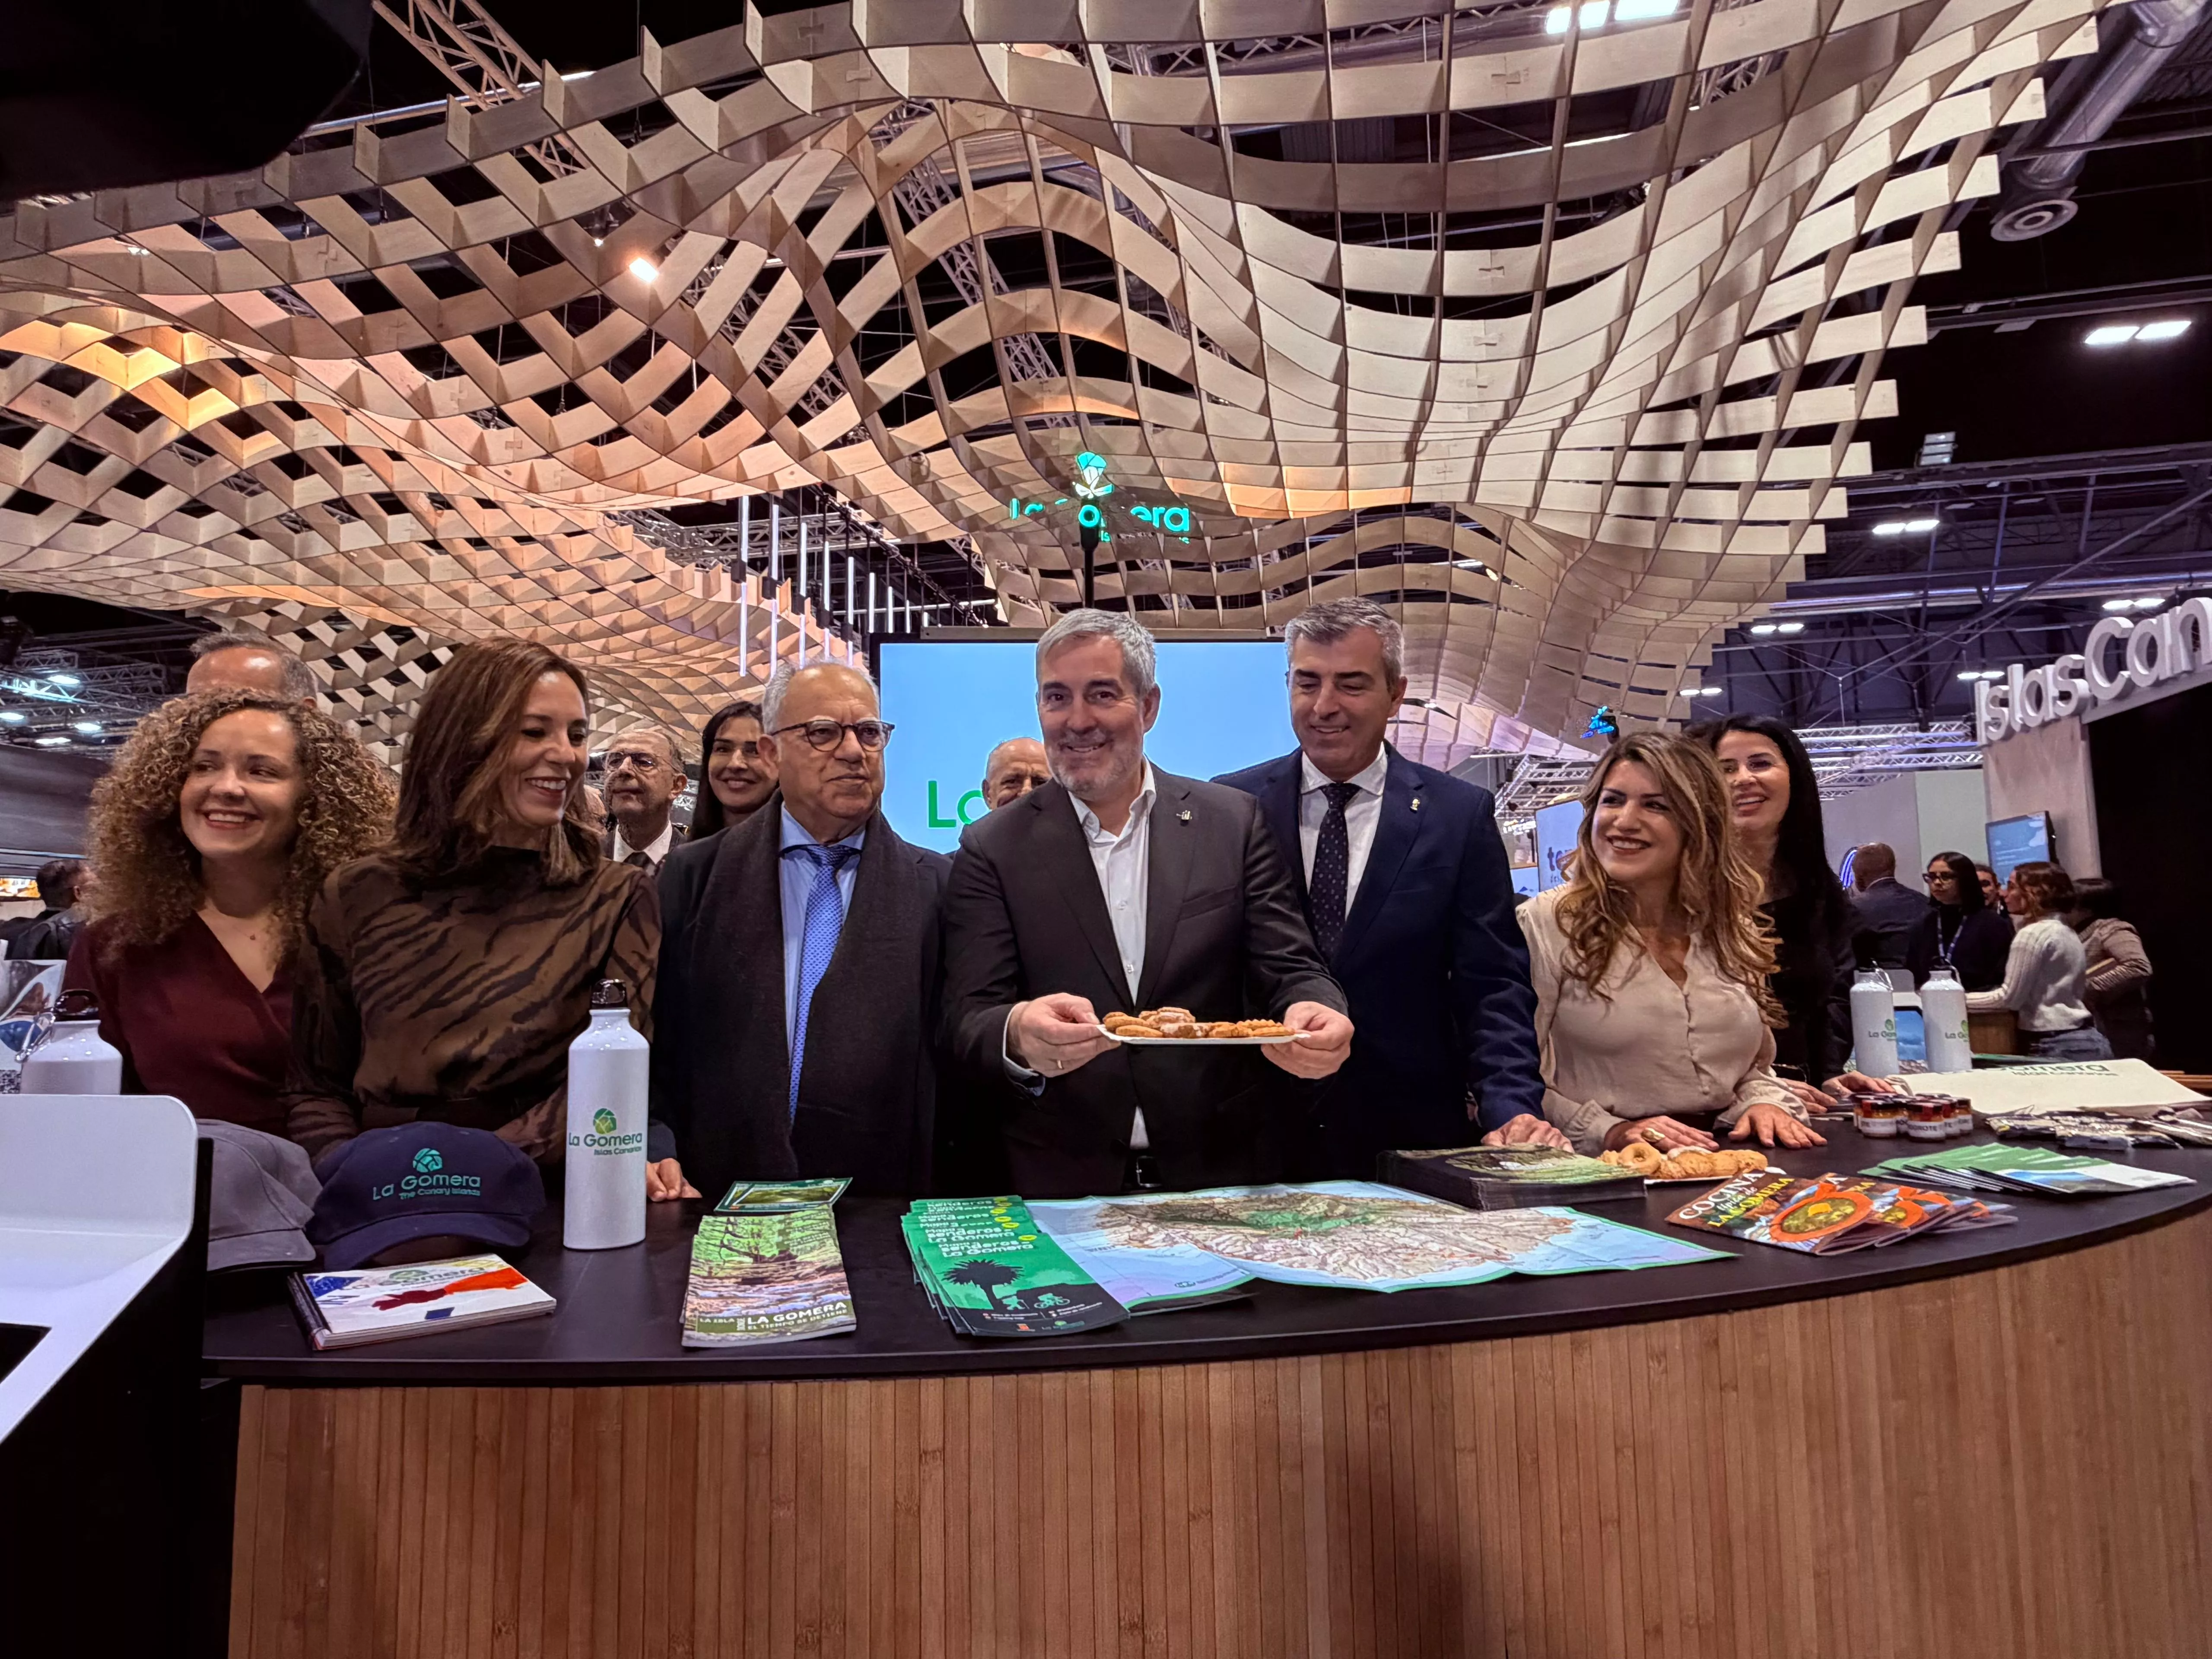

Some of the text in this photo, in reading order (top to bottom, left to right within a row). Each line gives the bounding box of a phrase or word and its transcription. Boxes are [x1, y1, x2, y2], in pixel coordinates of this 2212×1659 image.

[569, 1132, 642, 1147] La Gomera
[373, 1174, 481, 1200] La Gomera
[399, 1191, 416, 1200] The
[1679, 1172, 1766, 1219] COCINA
[1707, 1178, 1795, 1227] LA GOMERA
[951, 1232, 1015, 1241] Gomera
[966, 1244, 1034, 1255] Gomera
[747, 1316, 769, 1325] LA
[773, 1302, 847, 1322] GOMERA
